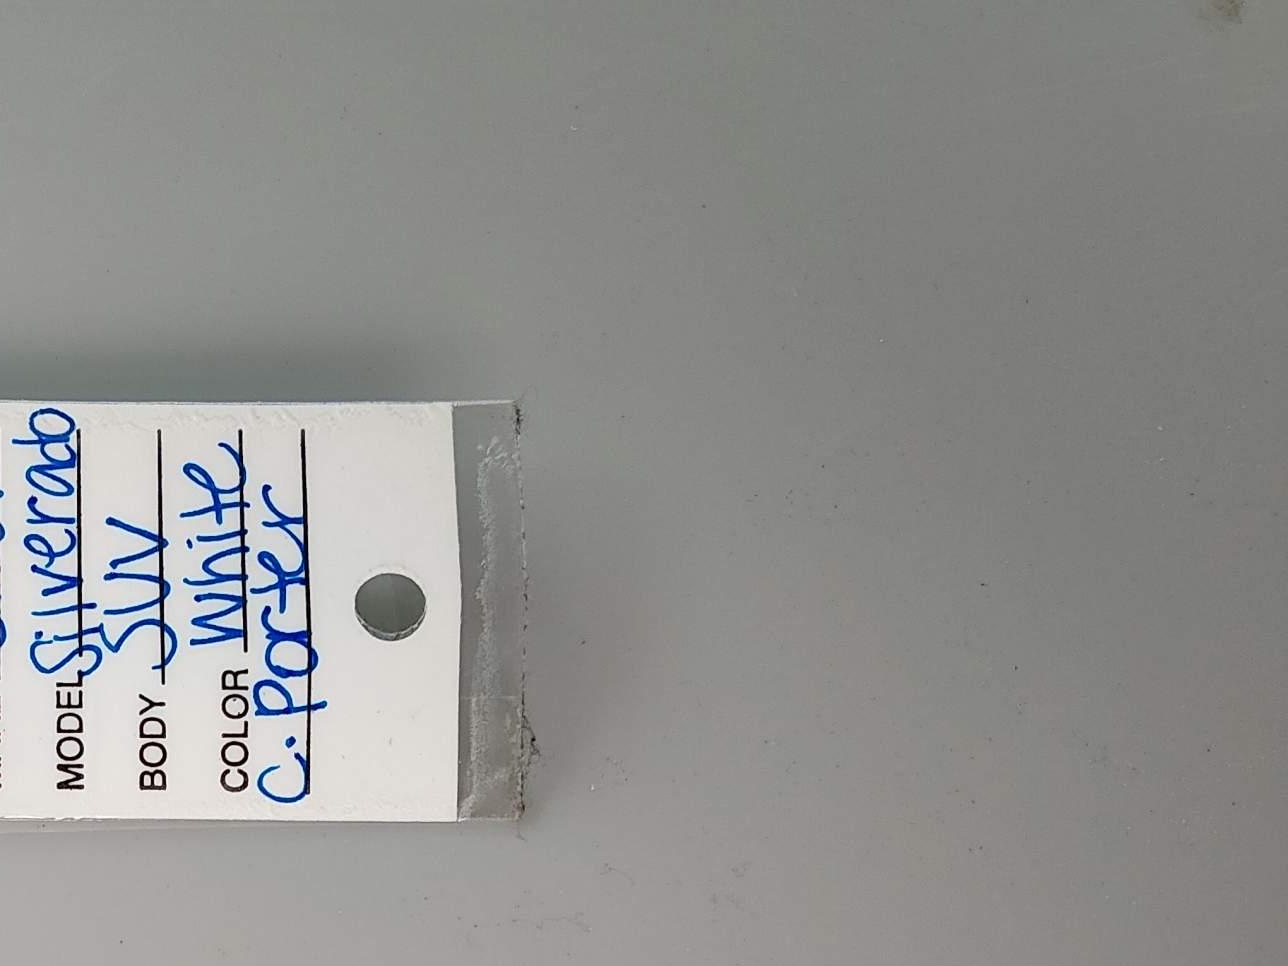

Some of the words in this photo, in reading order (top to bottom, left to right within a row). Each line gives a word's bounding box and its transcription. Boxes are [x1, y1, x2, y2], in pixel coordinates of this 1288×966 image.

[11, 406, 103, 678] Silverado
[100, 516, 177, 671] SUV
[178, 441, 251, 648] White
[55, 668, 85, 791] MODEL
[138, 692, 167, 792] BODY
[220, 667, 250, 793] COLOR
